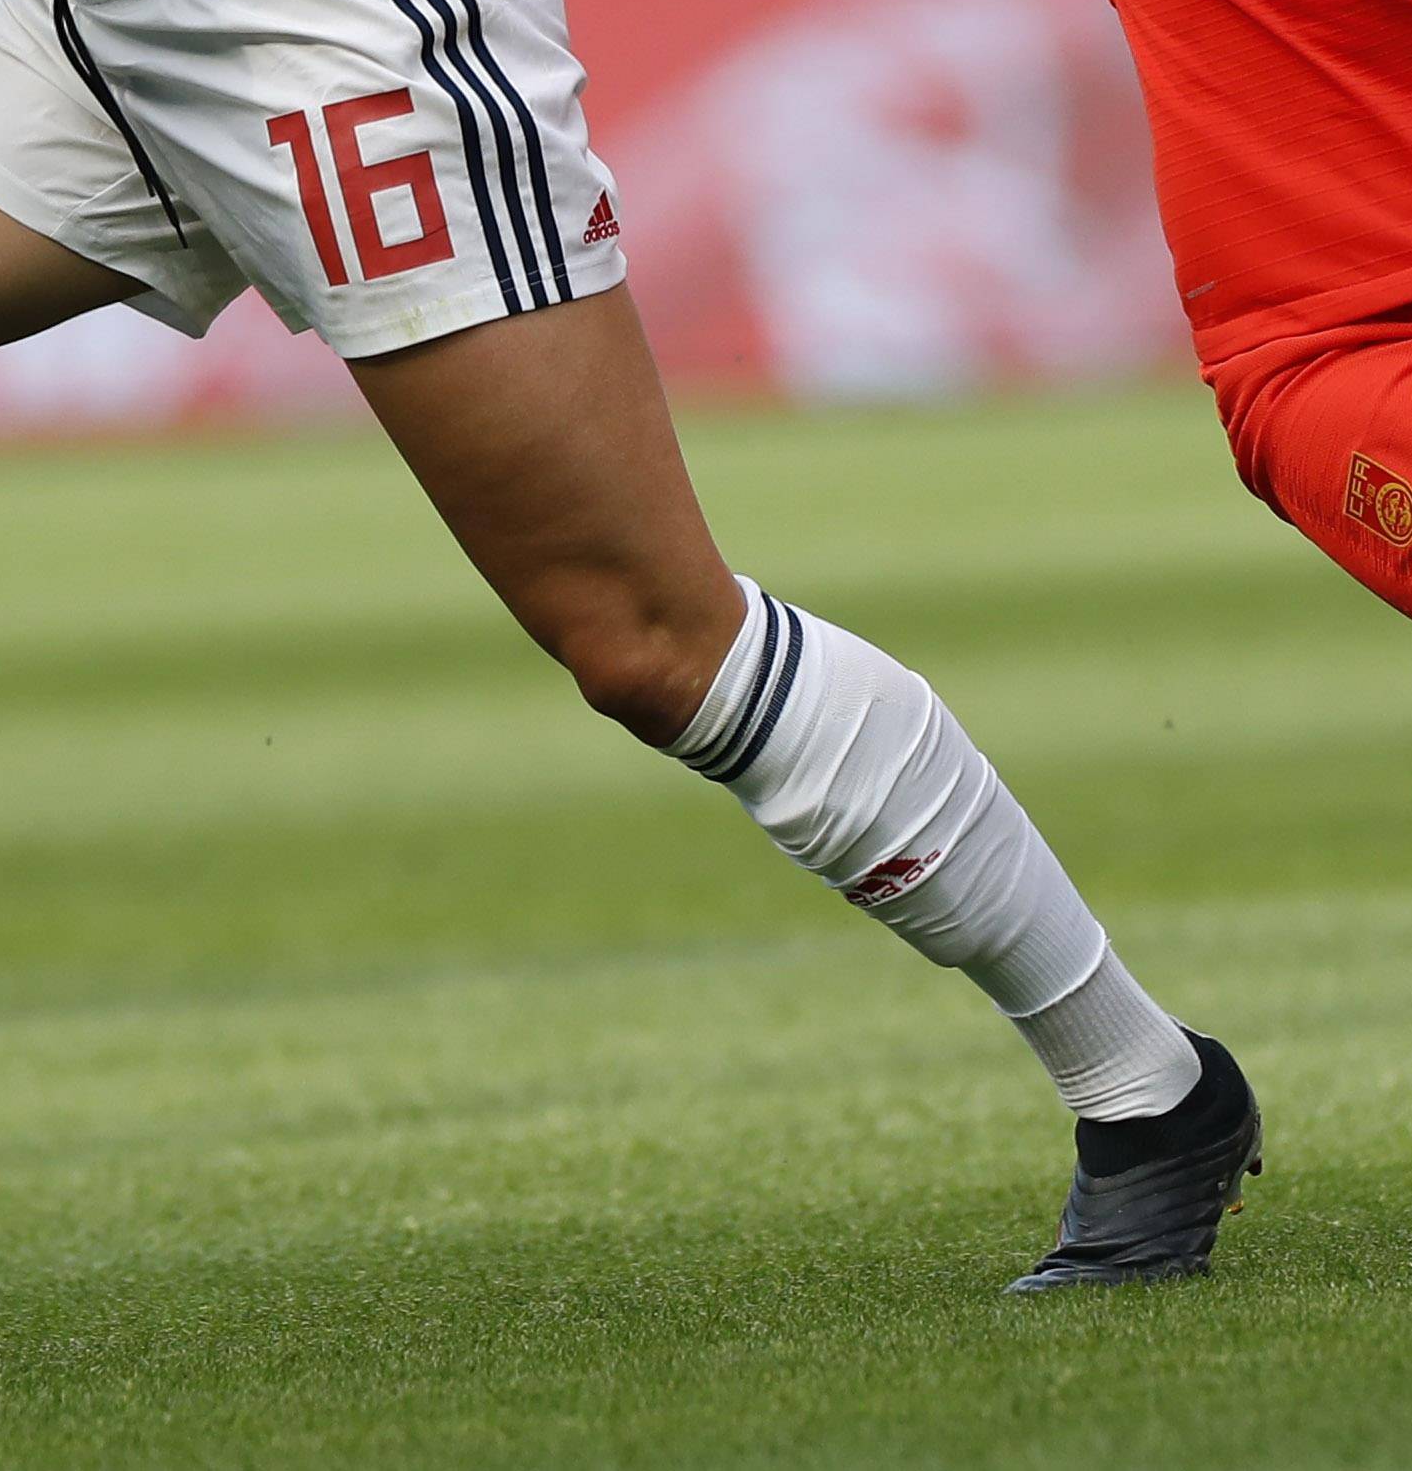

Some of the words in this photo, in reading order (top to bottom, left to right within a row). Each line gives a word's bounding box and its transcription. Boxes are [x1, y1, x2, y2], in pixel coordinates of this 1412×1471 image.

[265, 86, 456, 288] 16
[582, 220, 621, 244] adidas
[1348, 458, 1371, 519] CFA
